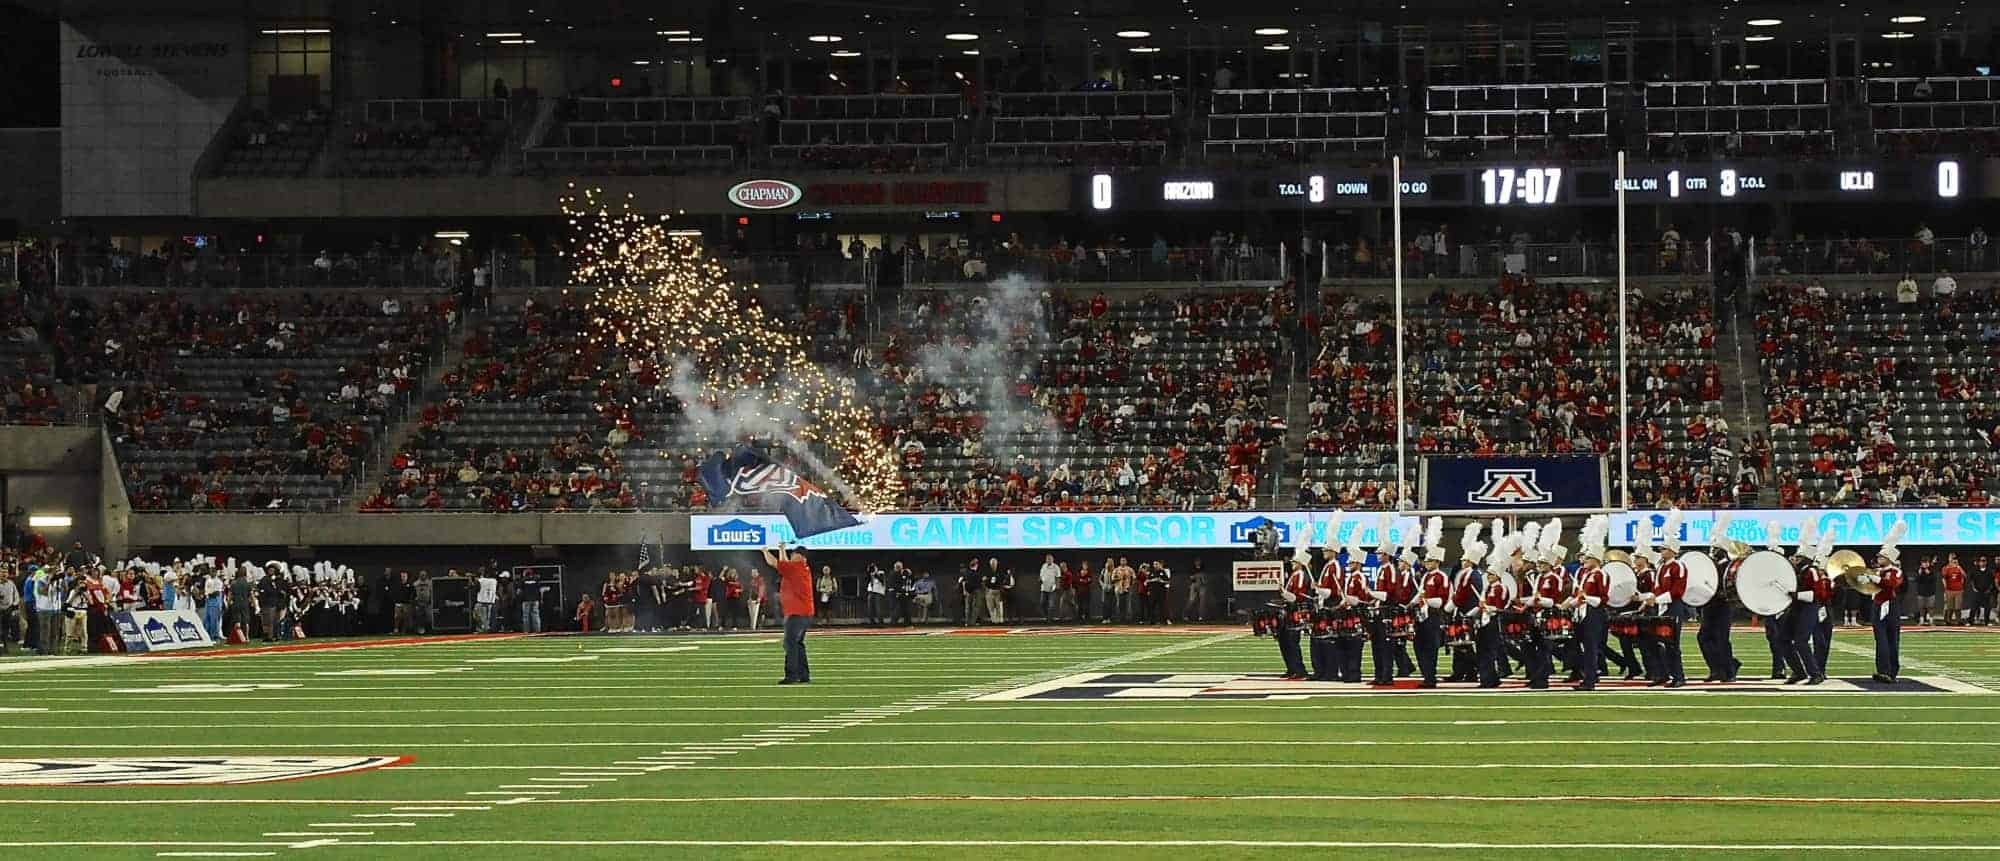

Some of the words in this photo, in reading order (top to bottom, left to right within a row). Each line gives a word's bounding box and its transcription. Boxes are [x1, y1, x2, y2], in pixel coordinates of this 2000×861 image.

[1092, 174, 1112, 209] 0
[1163, 181, 1214, 200] ARIZONA
[1309, 175, 1324, 202] 3
[1336, 183, 1368, 194] DOWN
[1411, 182, 1428, 194] GO
[1481, 167, 1562, 204] 17:07
[1642, 178, 1658, 190] ON
[1667, 170, 1679, 198] 1
[1685, 178, 1707, 189] QTR
[1720, 169, 1736, 196] 3
[1840, 171, 1874, 190] UCLA
[1938, 161, 1959, 197] 0
[738, 187, 789, 201] CHAPMAN
[713, 528, 761, 543] LOWE'S
[889, 515, 1010, 546] GAME
[1021, 514, 1216, 546] SPONSOR
[1817, 511, 1944, 543] GAME
